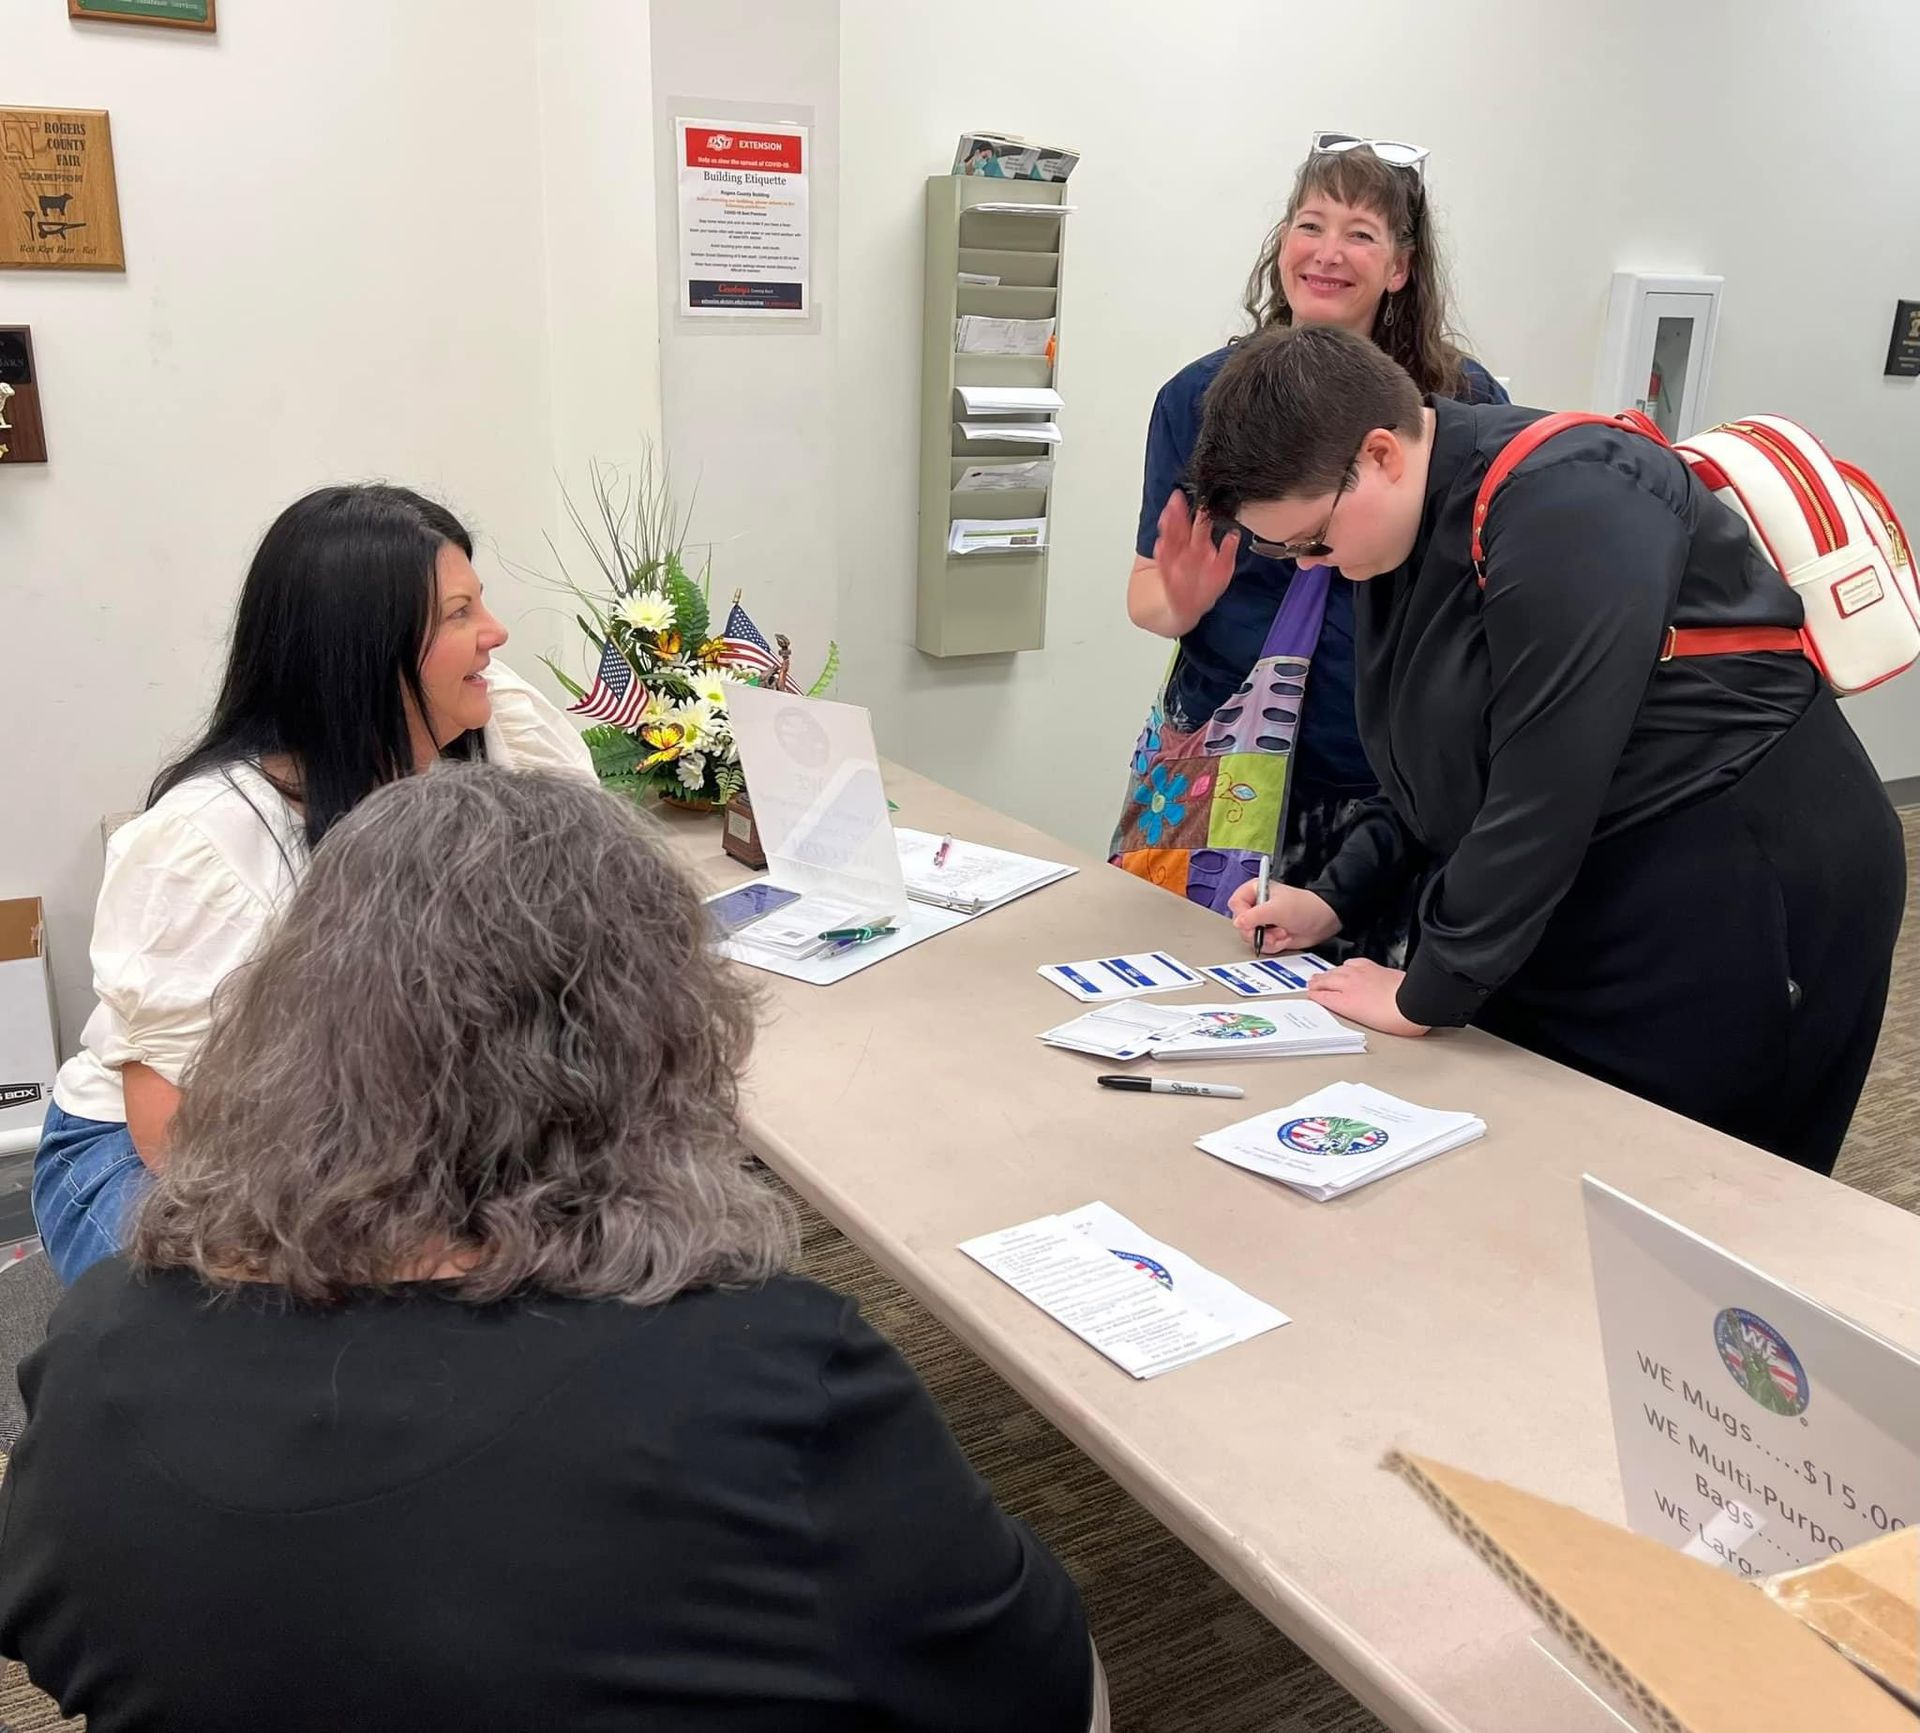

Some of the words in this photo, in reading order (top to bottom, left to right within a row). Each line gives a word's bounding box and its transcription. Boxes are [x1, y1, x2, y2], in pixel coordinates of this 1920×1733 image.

[45, 122, 86, 136] ROGERS
[47, 138, 86, 151] COUNTY
[739, 140, 782, 151] EXTENSION
[56, 154, 81, 167] FAIR
[20, 172, 83, 183] CHAMPION
[703, 171, 742, 185] Building
[745, 173, 787, 186] Etiquette
[5, 1088, 36, 1100] BOX
[1741, 1322, 1778, 1360] WE
[1637, 1350, 1674, 1392] WE
[1644, 1402, 1680, 1445] WE
[1654, 1489, 1692, 1532] WE
